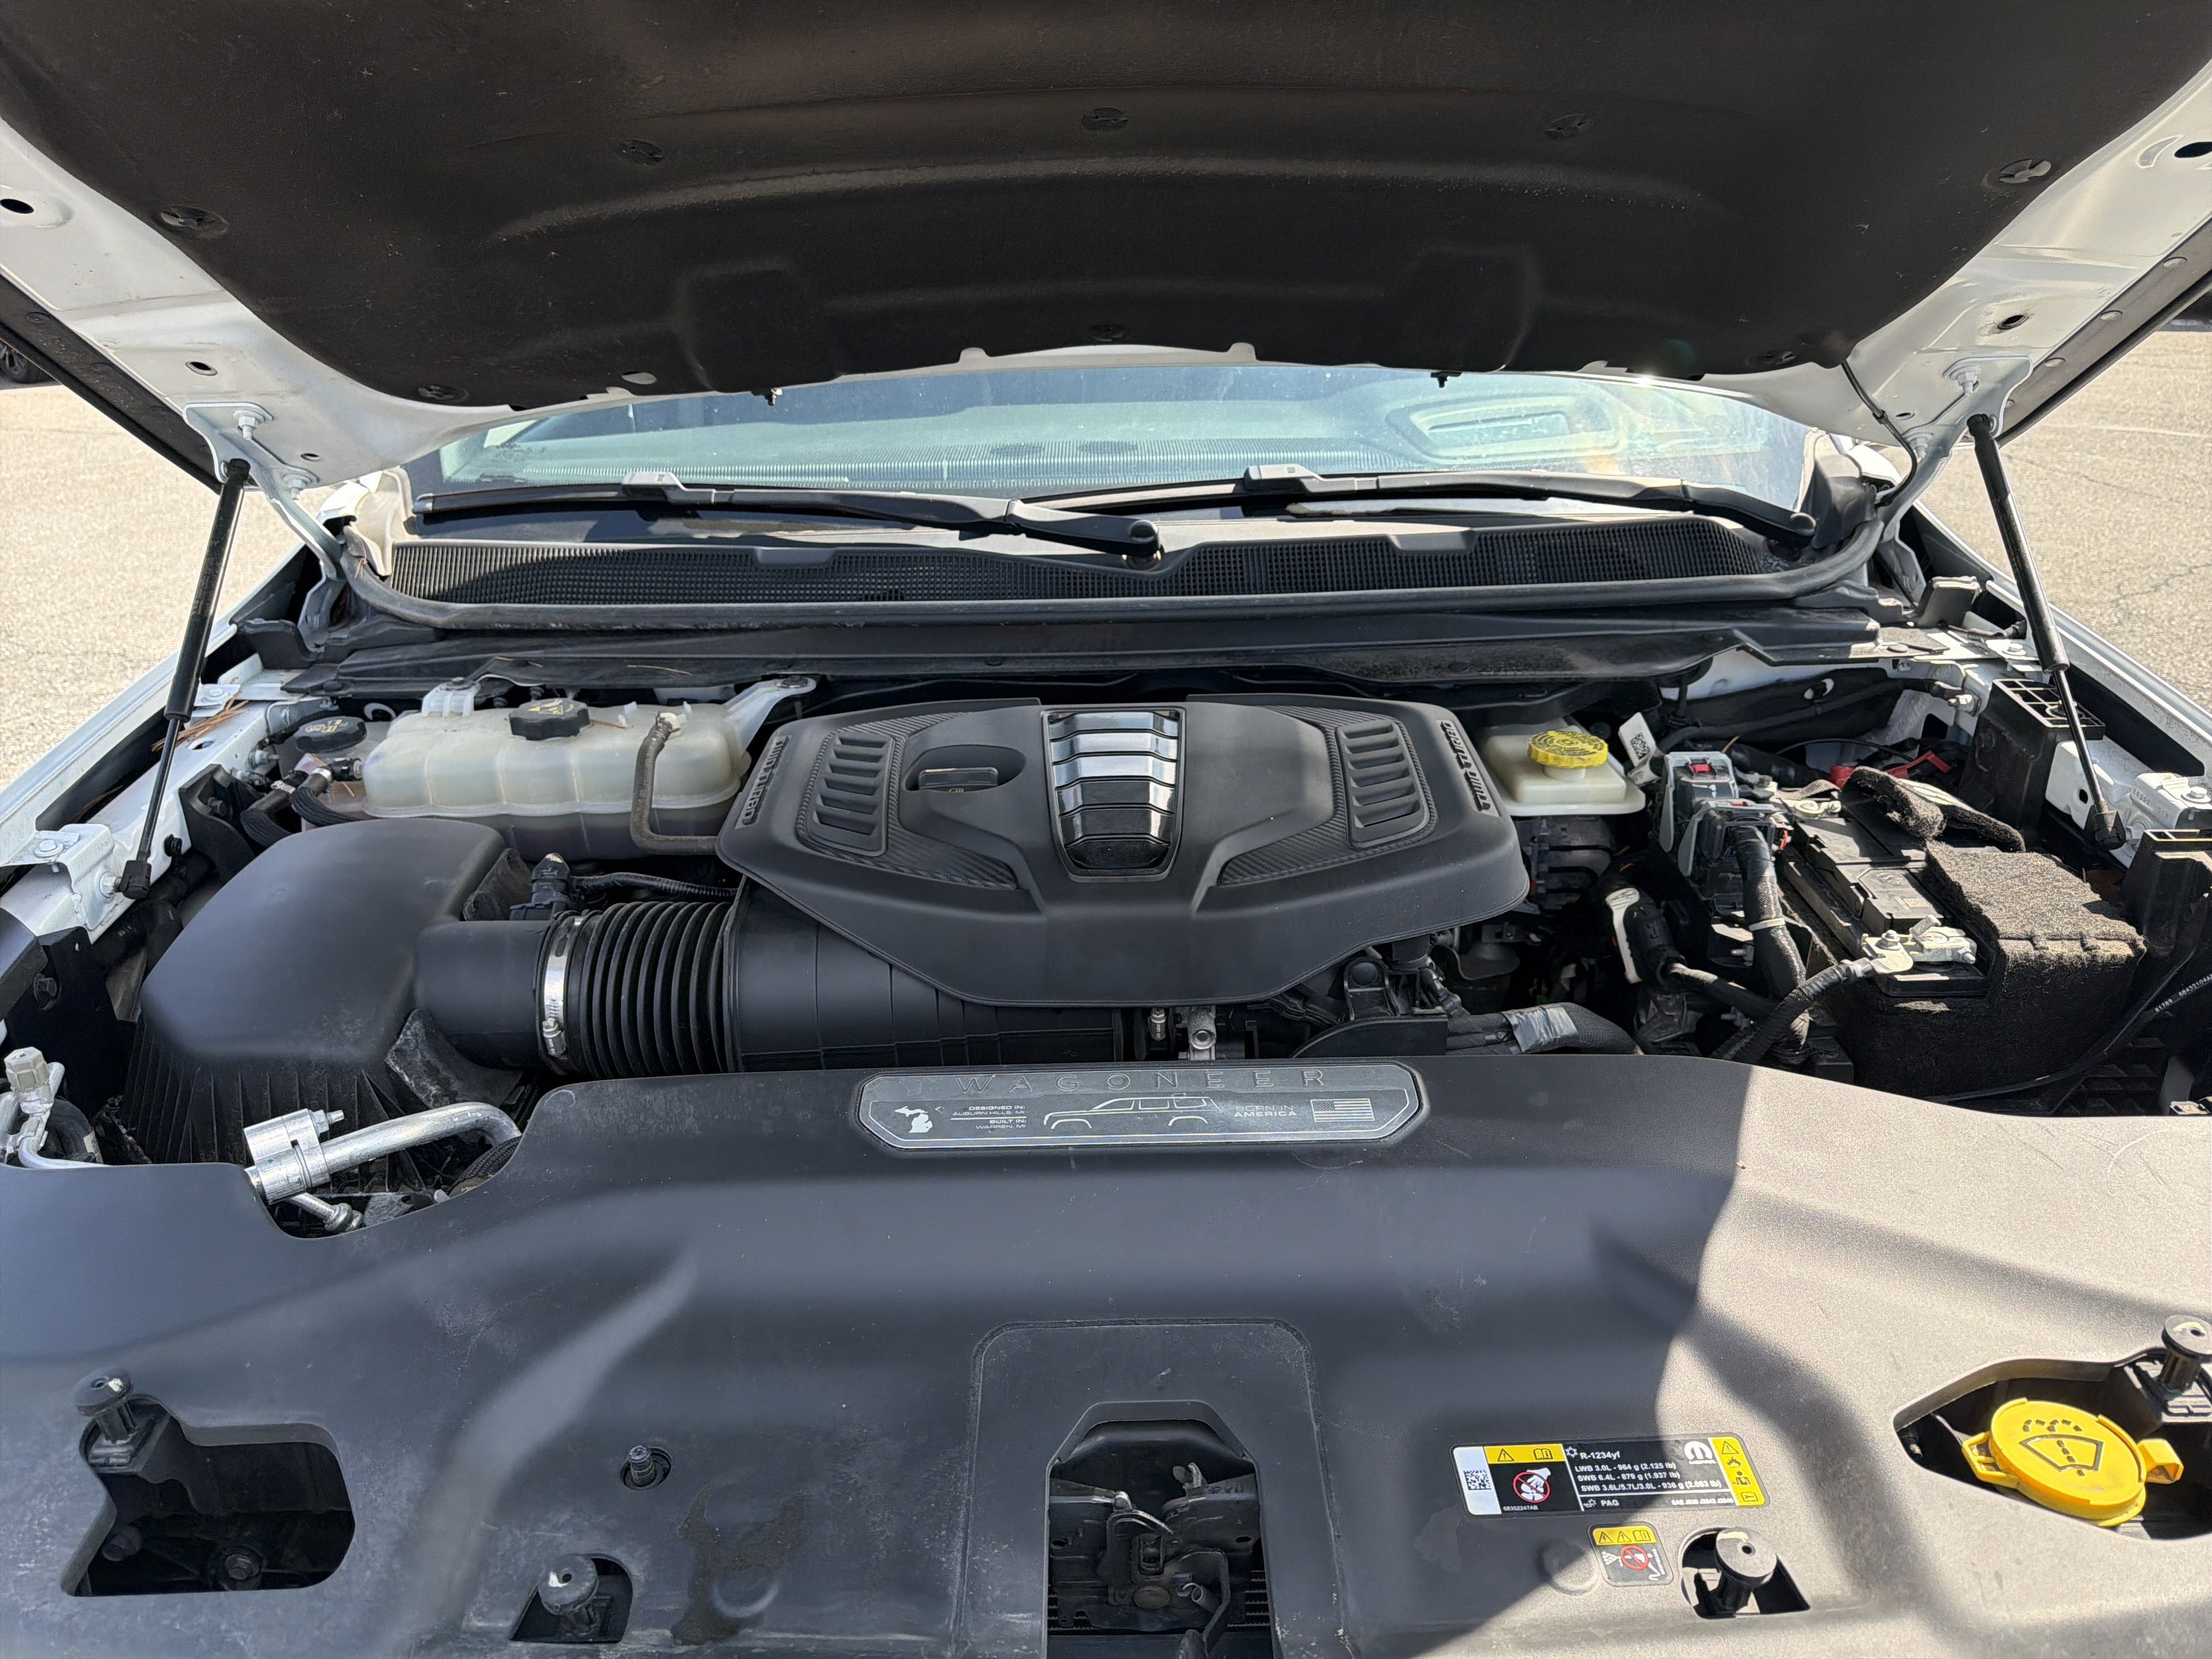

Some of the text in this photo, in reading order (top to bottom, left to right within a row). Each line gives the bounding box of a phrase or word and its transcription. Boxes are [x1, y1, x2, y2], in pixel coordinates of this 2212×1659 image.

[1441, 721, 1472, 769] TURBO
[954, 1070, 1324, 1093] WAGONEER
[1580, 1451, 1621, 1460] R-1234yf
[1641, 1463, 1664, 1471] (2.125
[1665, 1462, 1677, 1470] lb)
[1645, 1472, 1667, 1480] (1.937
[1669, 1471, 1680, 1480] lb)
[1602, 1483, 1656, 1491] 3.6L/5.7L/3.0L
[1709, 1480, 1722, 1488] lb)
